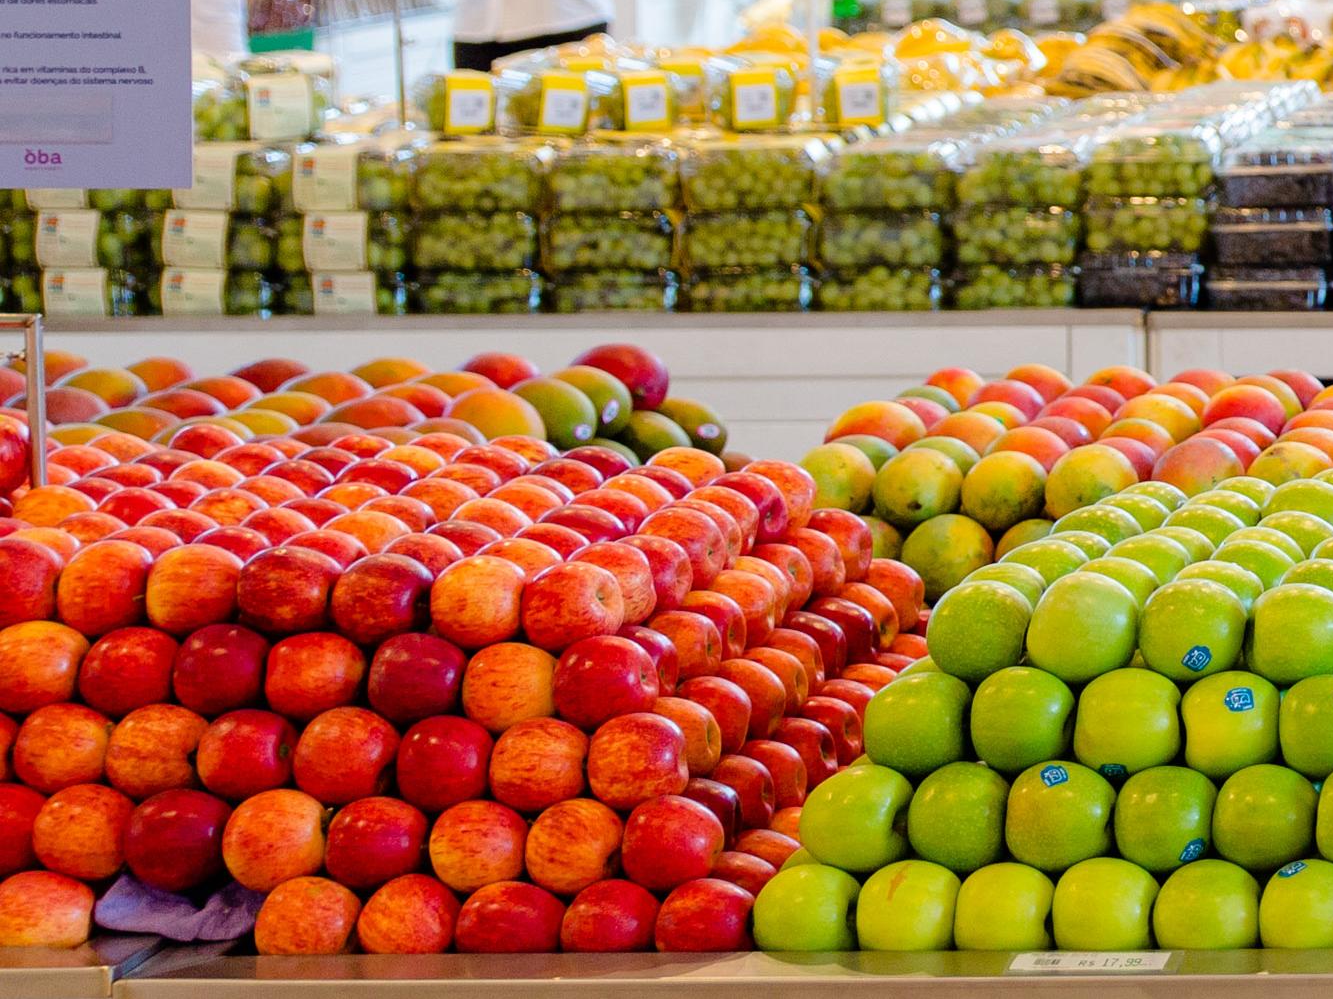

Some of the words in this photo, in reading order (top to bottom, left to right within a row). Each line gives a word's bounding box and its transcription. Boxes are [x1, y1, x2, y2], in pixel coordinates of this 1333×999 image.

[13, 32, 81, 40] funcionamento
[92, 66, 137, 75] complexo
[30, 77, 68, 86] doenças
